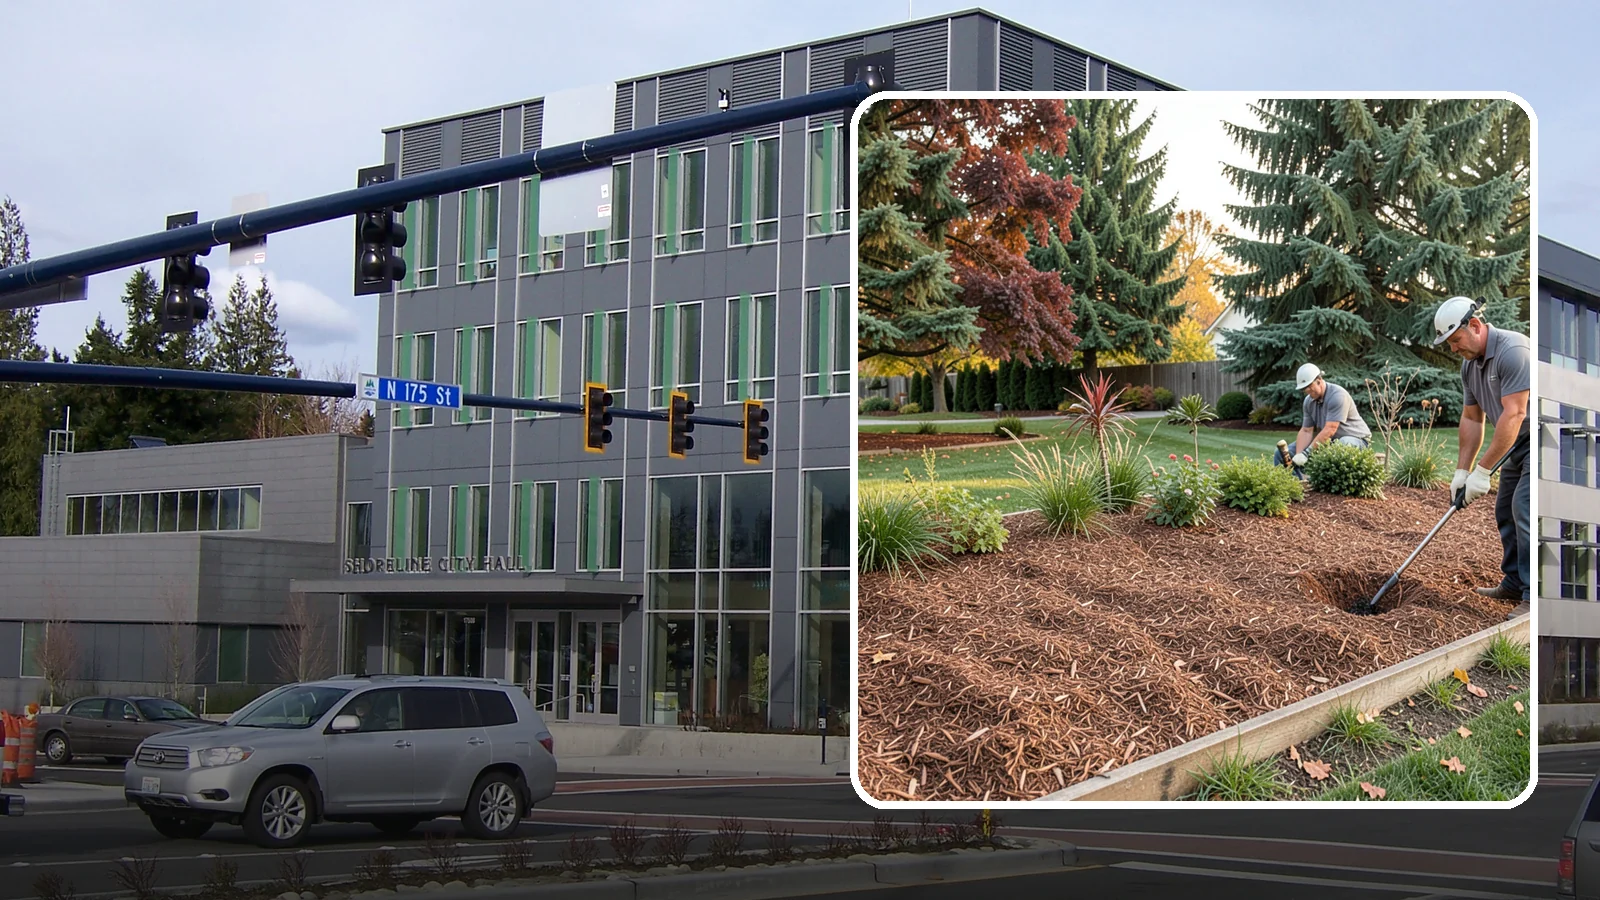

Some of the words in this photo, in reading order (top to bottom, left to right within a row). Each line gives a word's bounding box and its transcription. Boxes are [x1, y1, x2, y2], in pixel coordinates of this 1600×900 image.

[387, 380, 396, 400] N
[405, 383, 427, 403] 175
[436, 387, 451, 406] St
[344, 556, 432, 574] SHORELINE
[438, 556, 476, 572] CITY
[484, 555, 526, 572] HALL
